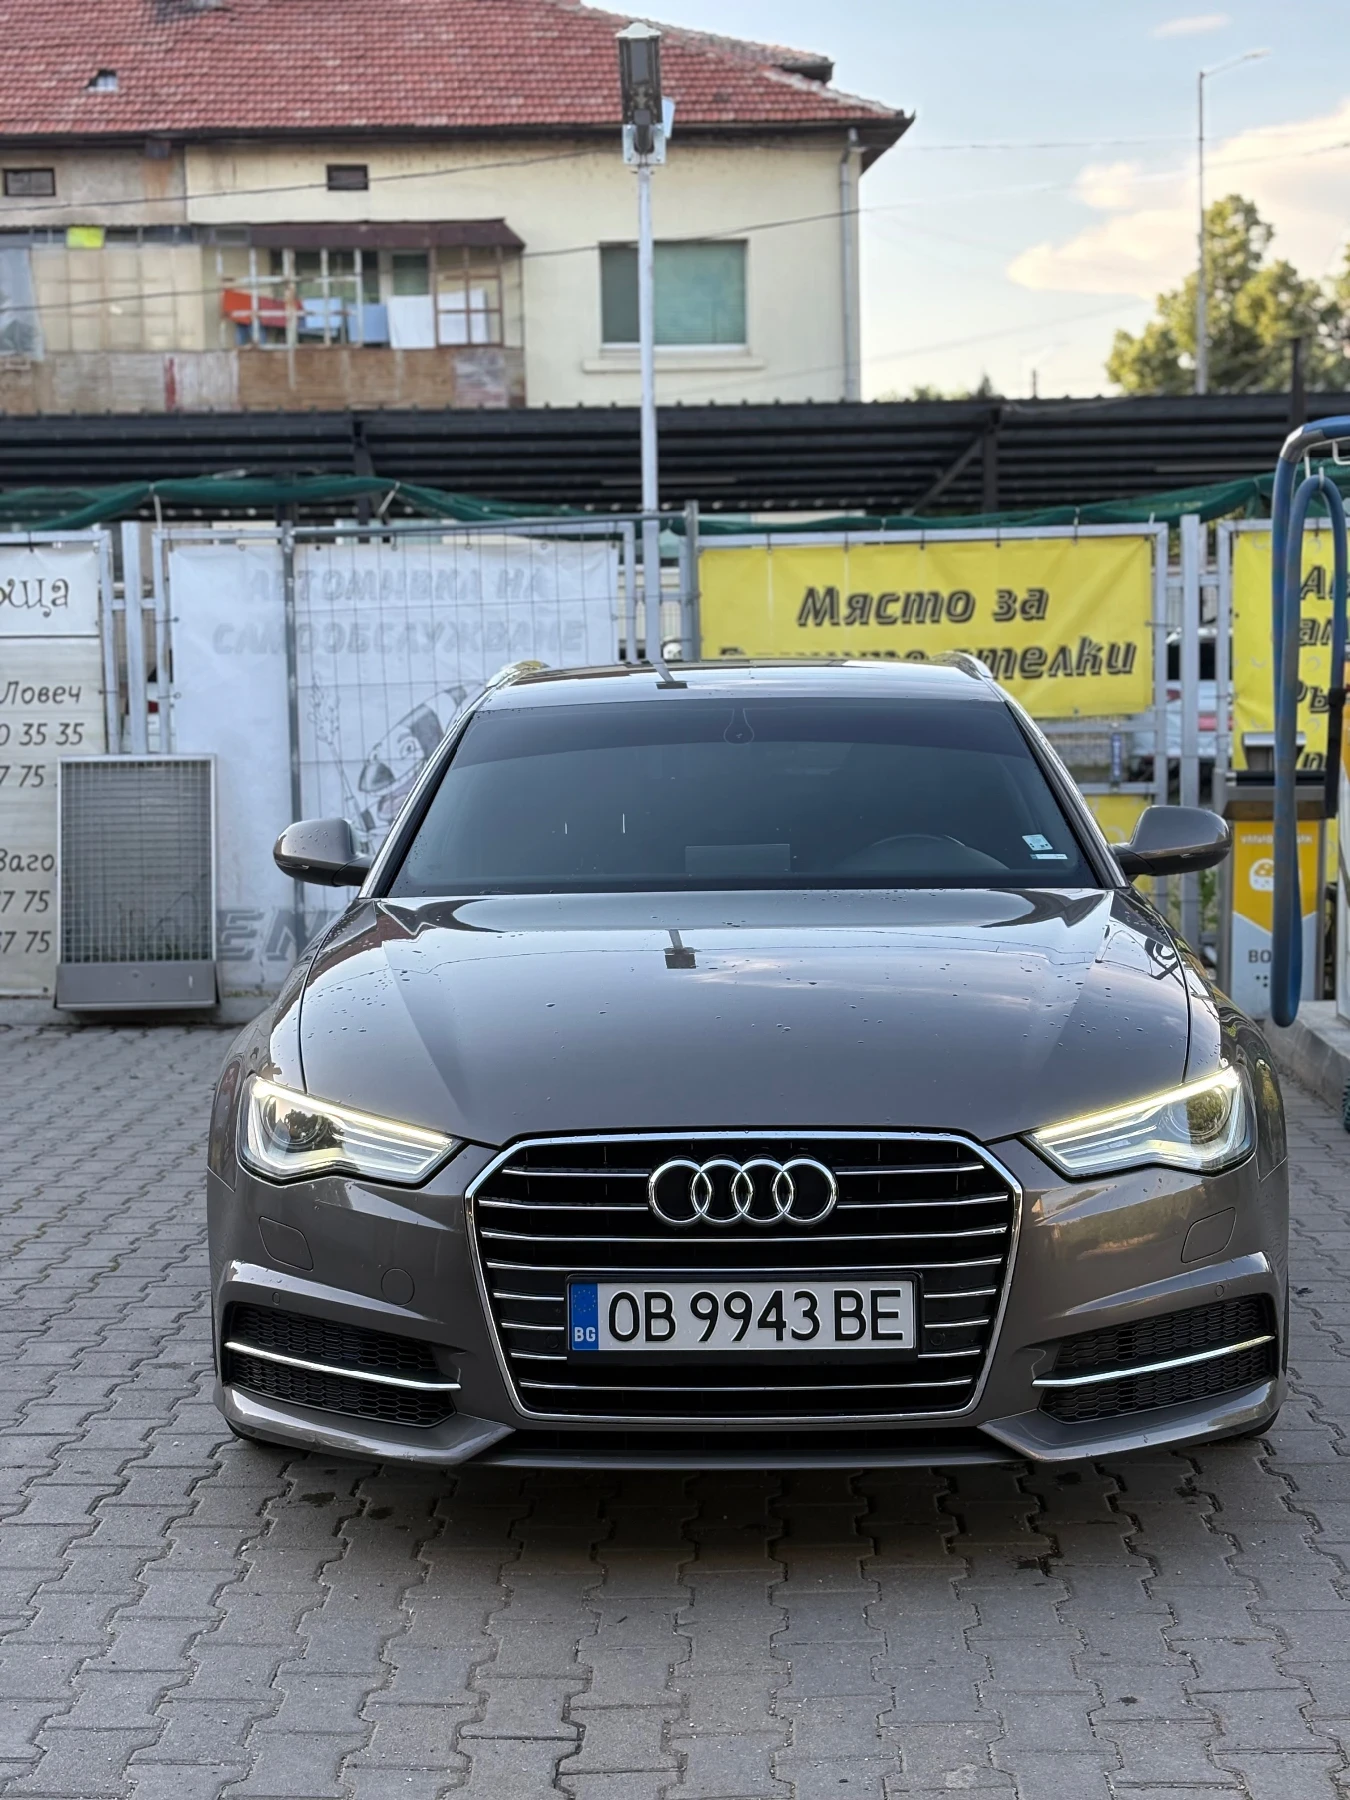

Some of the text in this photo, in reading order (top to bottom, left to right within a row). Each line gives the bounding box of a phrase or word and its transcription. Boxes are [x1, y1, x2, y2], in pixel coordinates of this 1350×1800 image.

[797, 586, 1049, 627] Място за
[0, 680, 82, 705] Ловеч
[19, 723, 48, 746] 35
[55, 722, 85, 746] 35
[19, 765, 46, 788] 75
[23, 890, 51, 914] 75
[24, 930, 52, 954] 75
[690, 1290, 821, 1342] 9943
[833, 1289, 904, 1341] BE
[574, 1326, 596, 1342] BG
